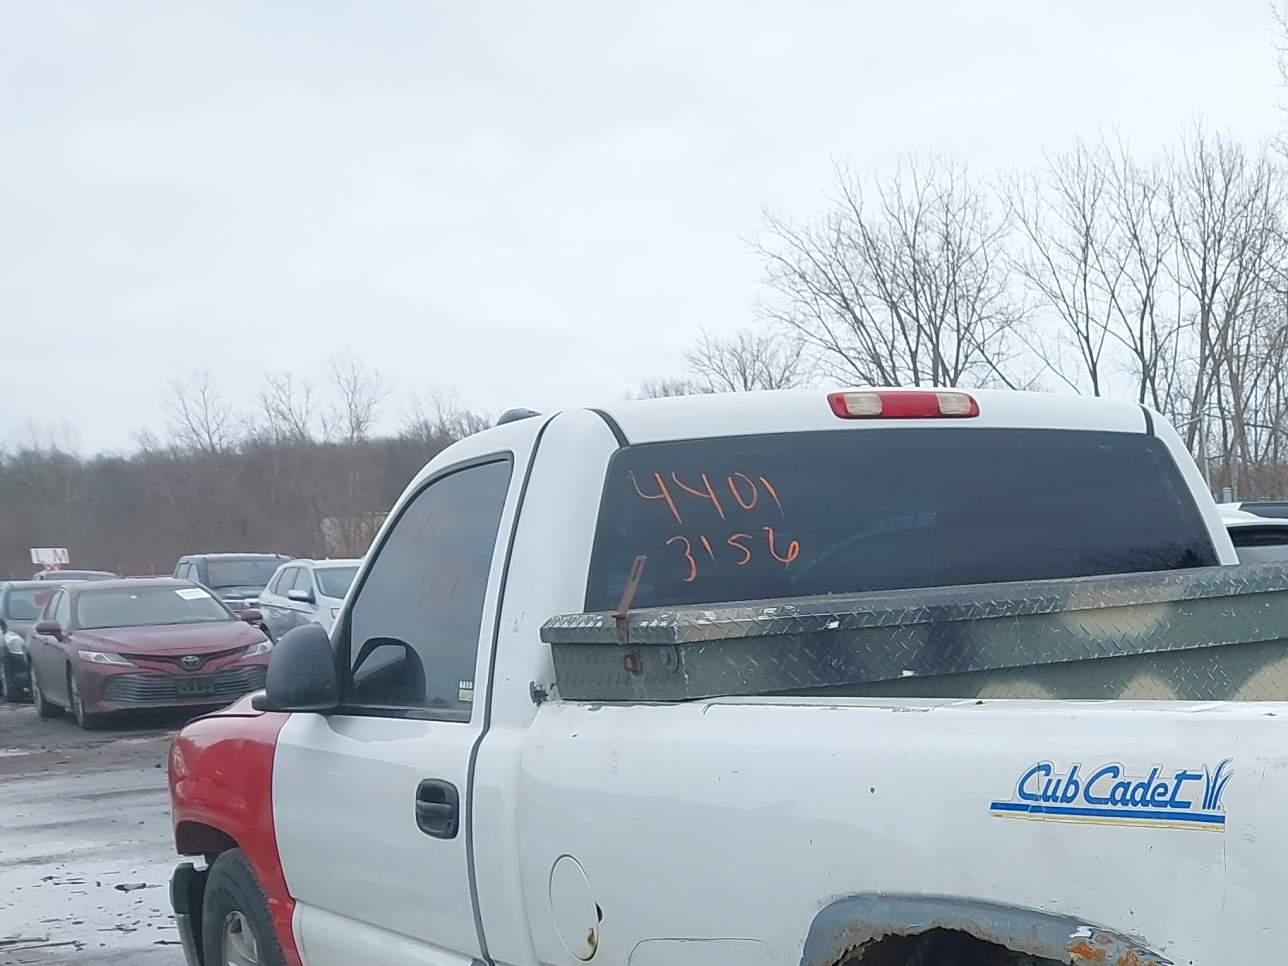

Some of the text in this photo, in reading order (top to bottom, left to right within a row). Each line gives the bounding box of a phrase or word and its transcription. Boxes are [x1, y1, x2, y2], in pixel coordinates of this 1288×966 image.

[628, 470, 785, 525] 4401
[665, 526, 801, 583] 3156
[1018, 763, 1203, 809] Cub Cadet
